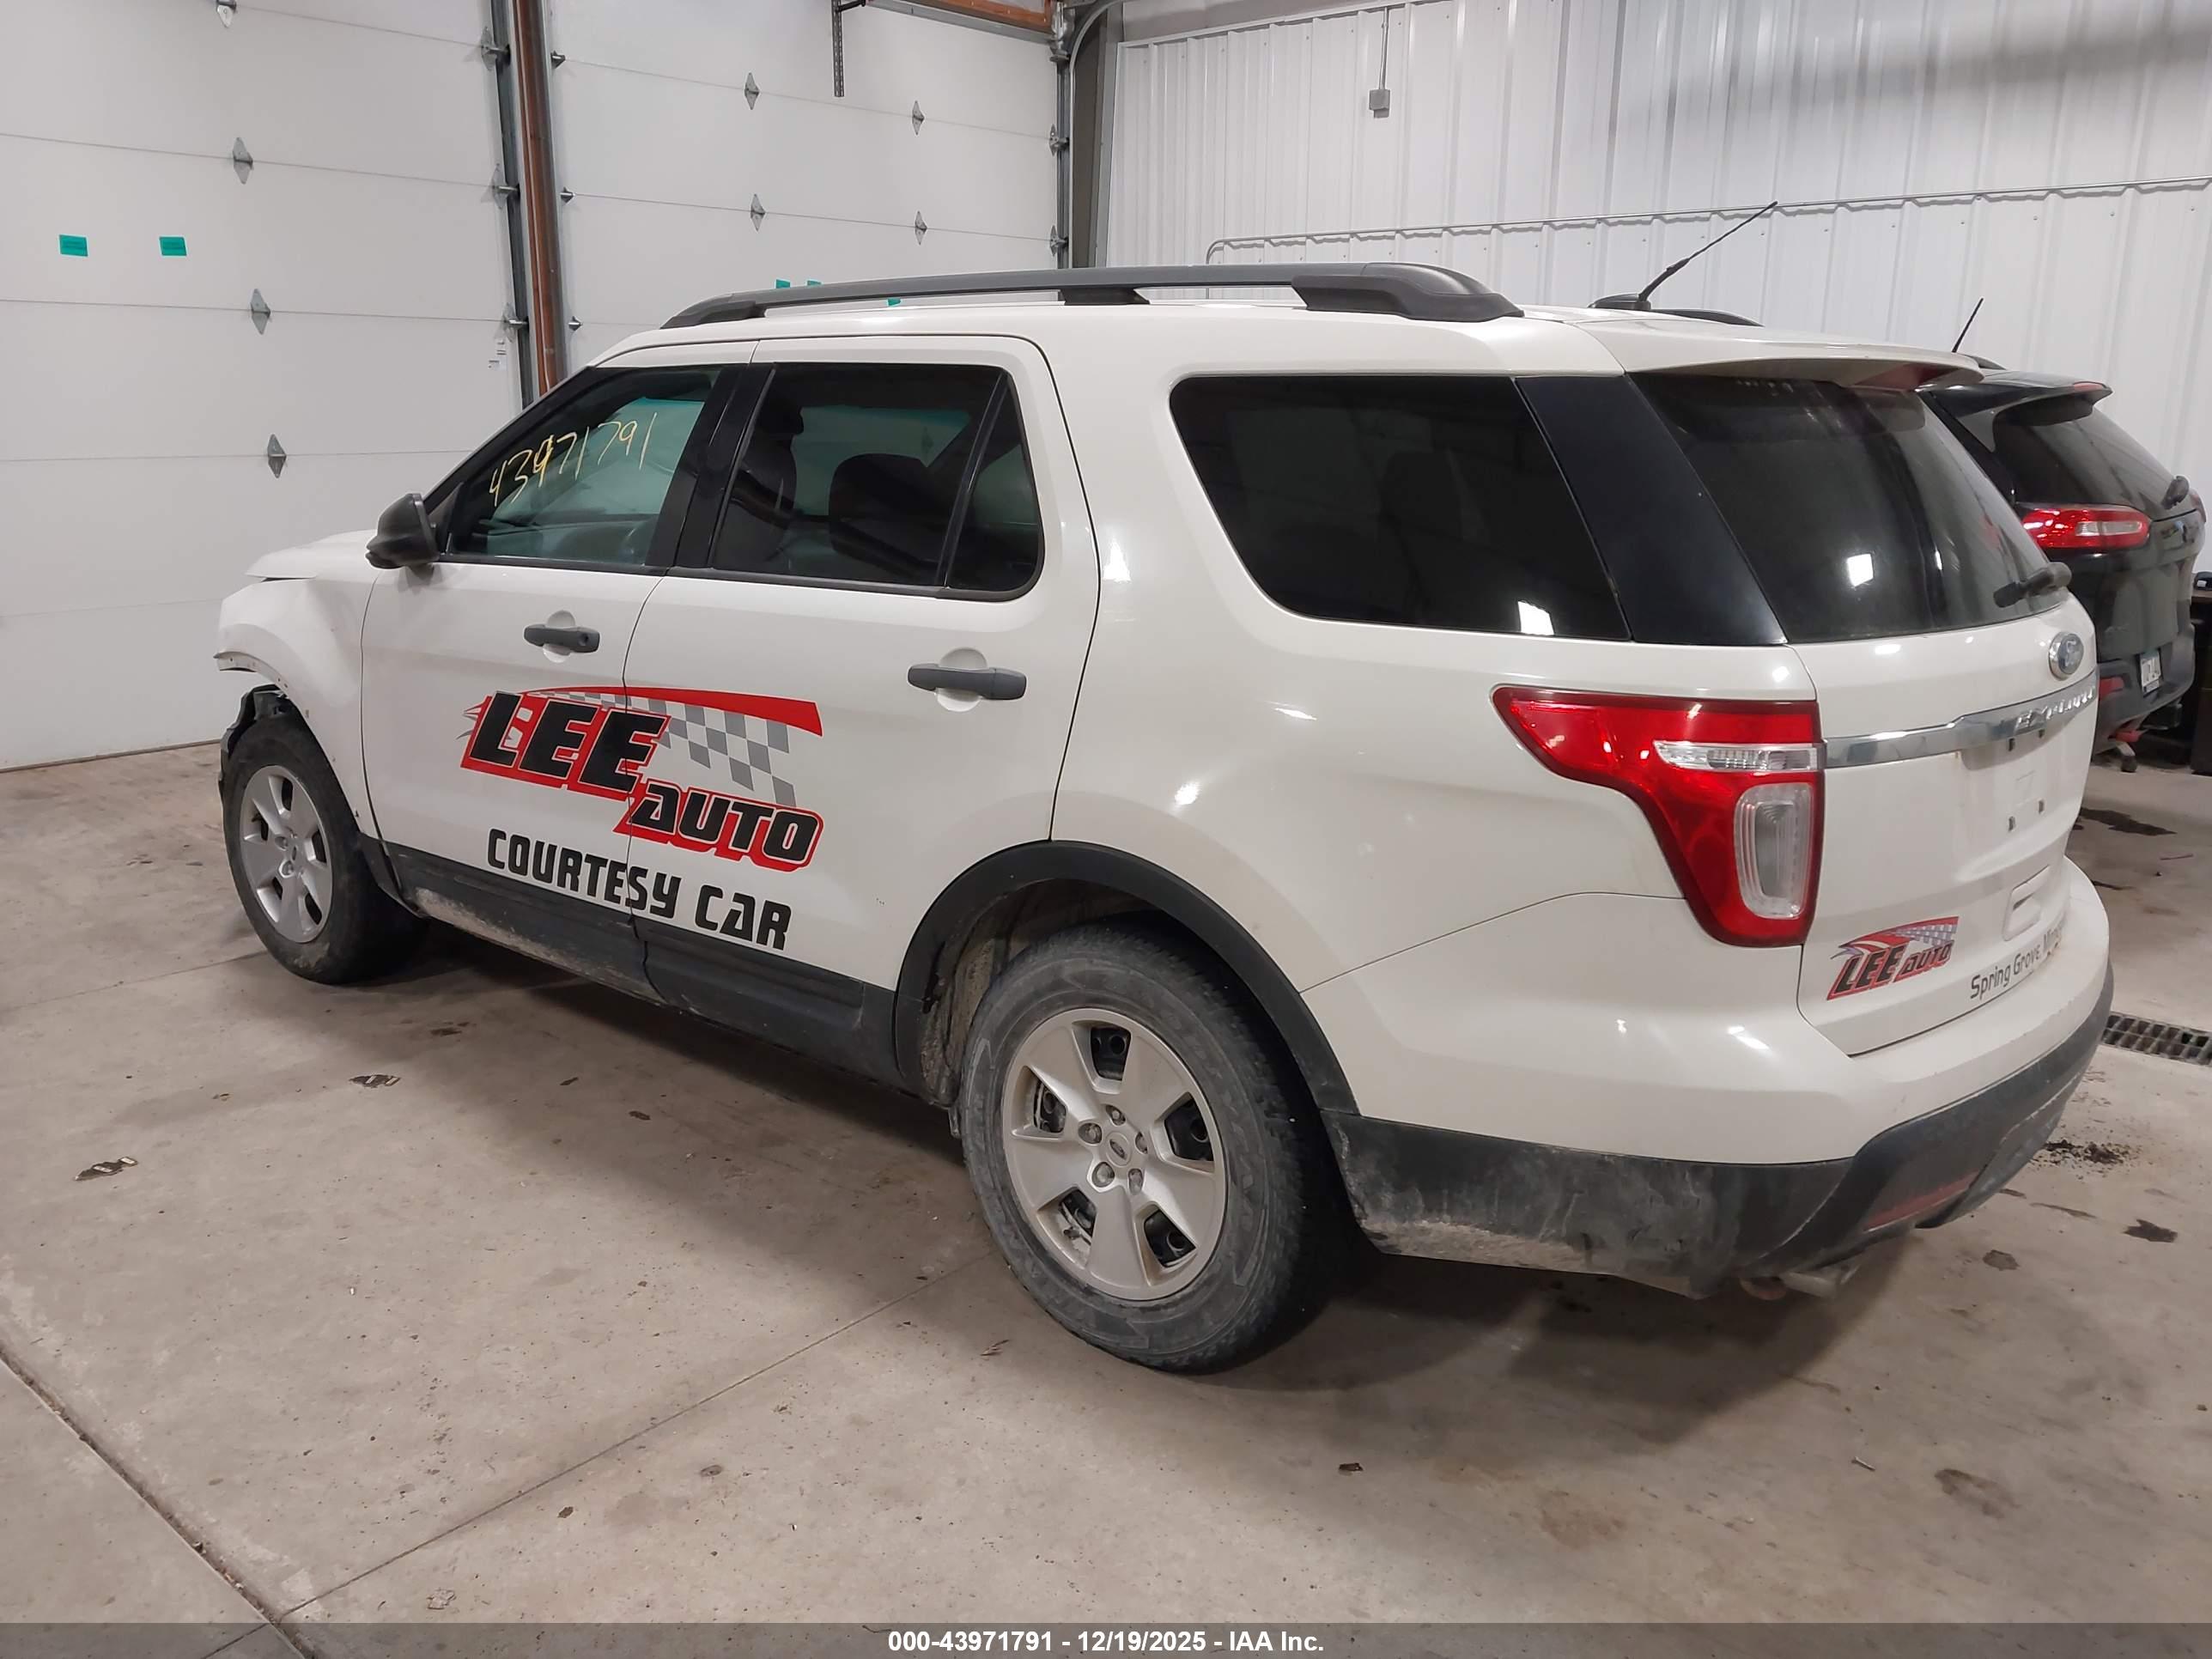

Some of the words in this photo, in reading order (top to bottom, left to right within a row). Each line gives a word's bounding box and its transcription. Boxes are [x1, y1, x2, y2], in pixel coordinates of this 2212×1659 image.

[489, 411, 658, 507] 43971791
[468, 691, 669, 793] LEE
[629, 782, 820, 862] AUTO
[487, 829, 682, 919] COURTESY
[694, 884, 792, 951] CAR
[1834, 945, 1905, 994] LEE
[1900, 940, 1955, 975] AUTO
[1970, 964, 2011, 1000] Spring
[2014, 944, 2040, 975] Grove
